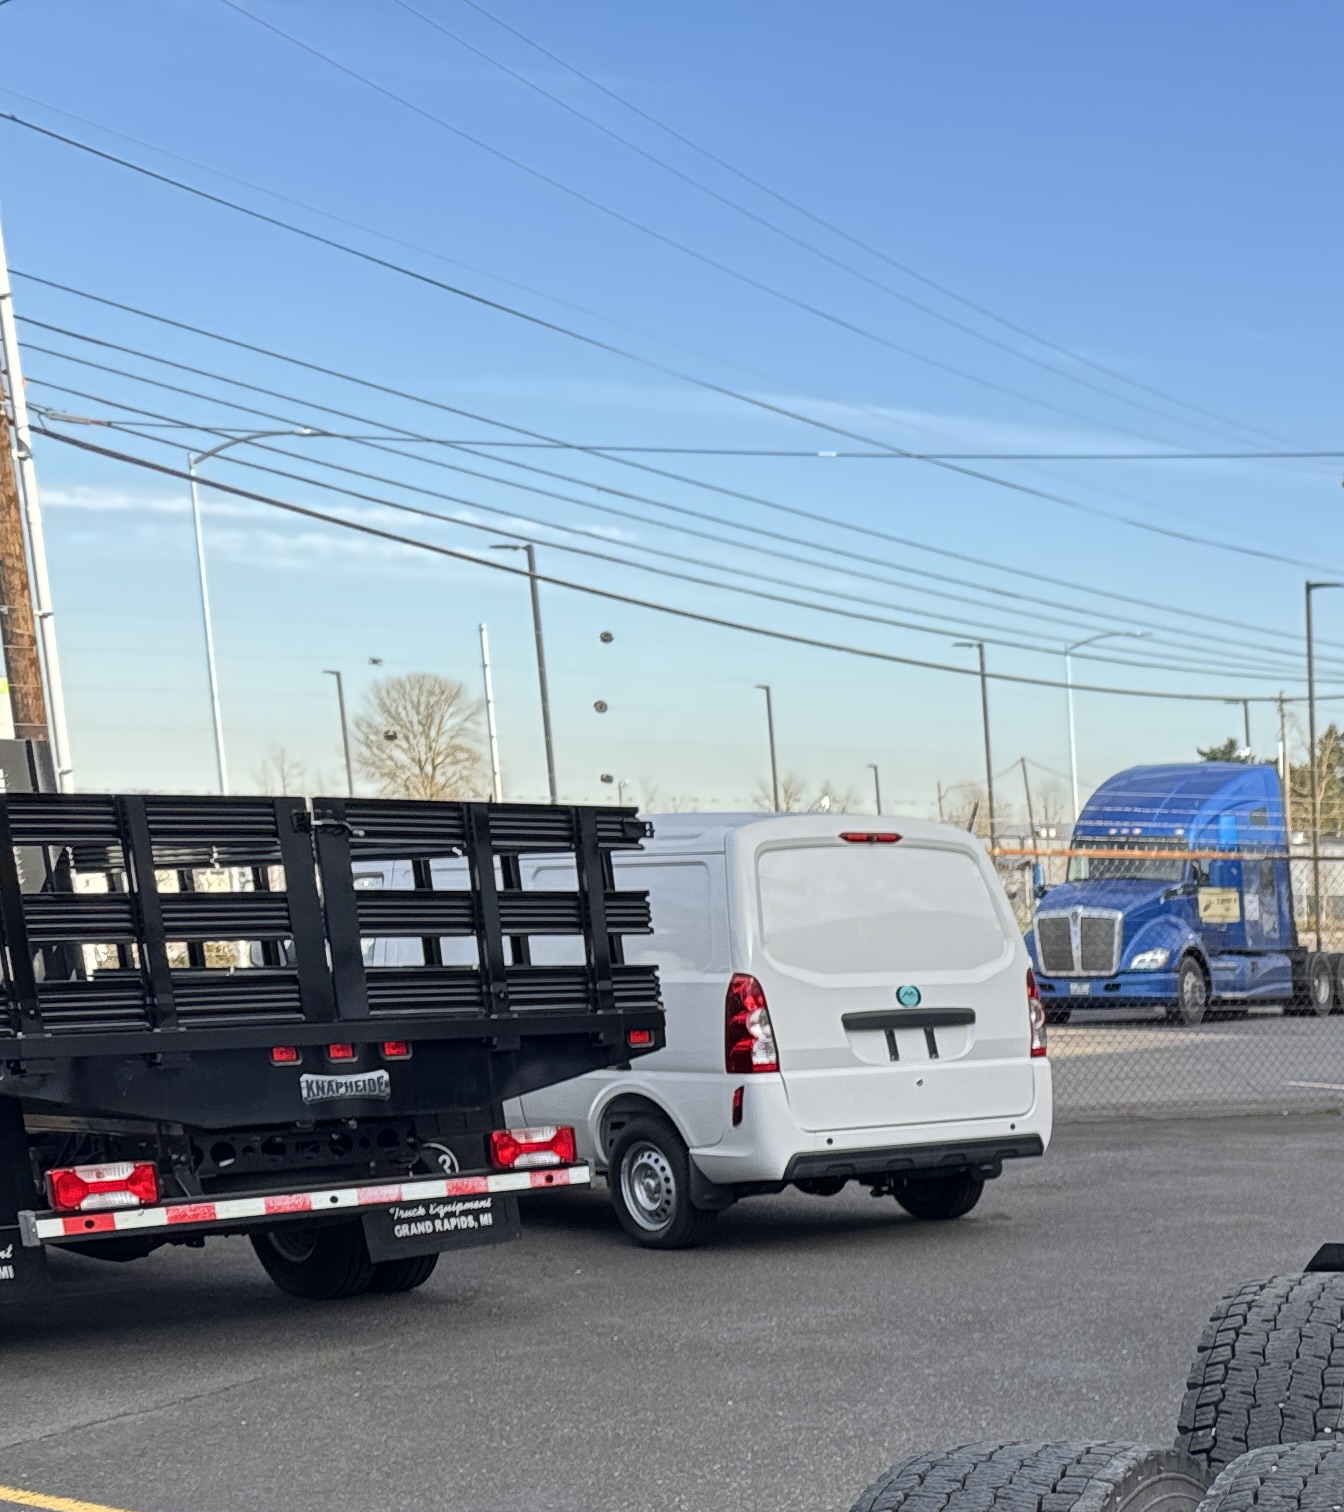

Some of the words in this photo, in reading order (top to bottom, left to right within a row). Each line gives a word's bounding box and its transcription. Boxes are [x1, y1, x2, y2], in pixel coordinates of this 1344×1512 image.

[394, 1220, 434, 1238] GRAND
[434, 1214, 479, 1232] RAPIDS,
[479, 1212, 493, 1227] MI
